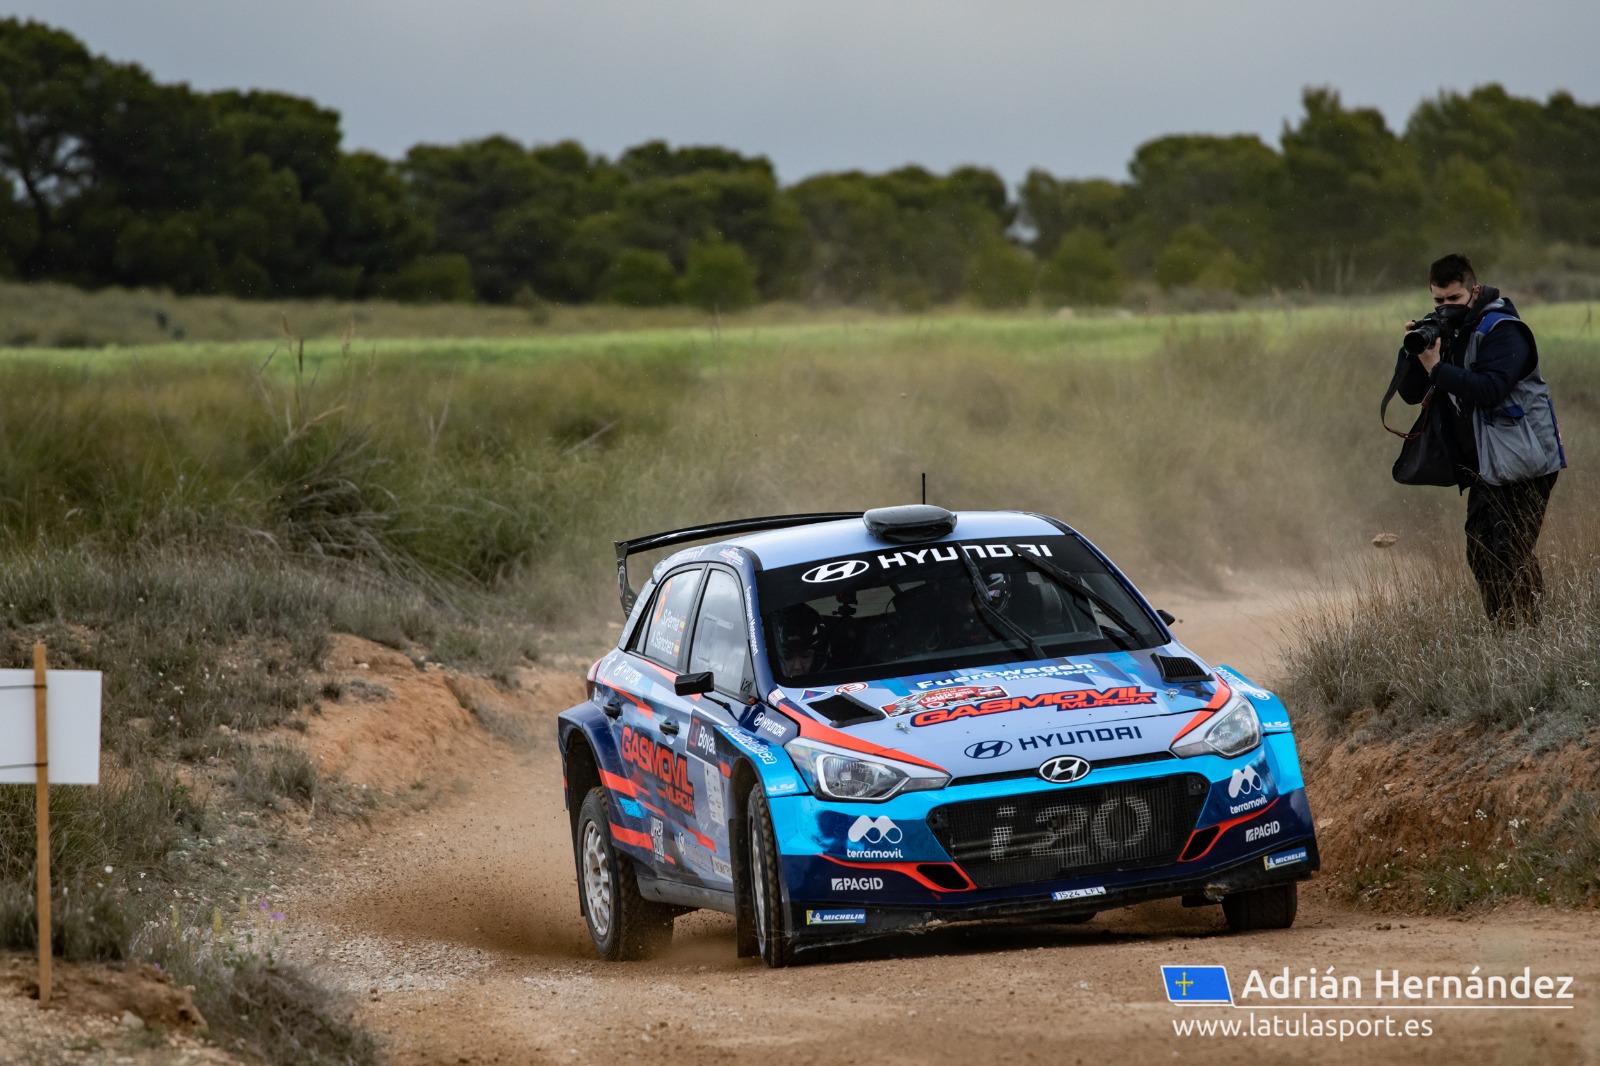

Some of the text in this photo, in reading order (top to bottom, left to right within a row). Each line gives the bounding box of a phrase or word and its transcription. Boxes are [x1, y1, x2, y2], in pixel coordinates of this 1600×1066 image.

[877, 544, 1052, 569] HYUNDAI
[916, 663, 1093, 690] Fuertwagen
[1005, 668, 1098, 682] Motorsport
[914, 687, 1153, 727] GASMOVIL
[1061, 696, 1152, 711] MURCIA
[763, 717, 787, 738] HYUNDAI
[1018, 726, 1142, 750] HYUNDAI
[622, 725, 693, 797] GASMOVIL
[1229, 794, 1268, 814] terramovil
[990, 796, 1151, 862] i20
[1254, 820, 1280, 840] PAGID
[846, 848, 903, 858] terramovil
[1275, 851, 1306, 864] MICHELIN
[843, 877, 883, 890] PAGID
[823, 913, 865, 921] MICHELIN
